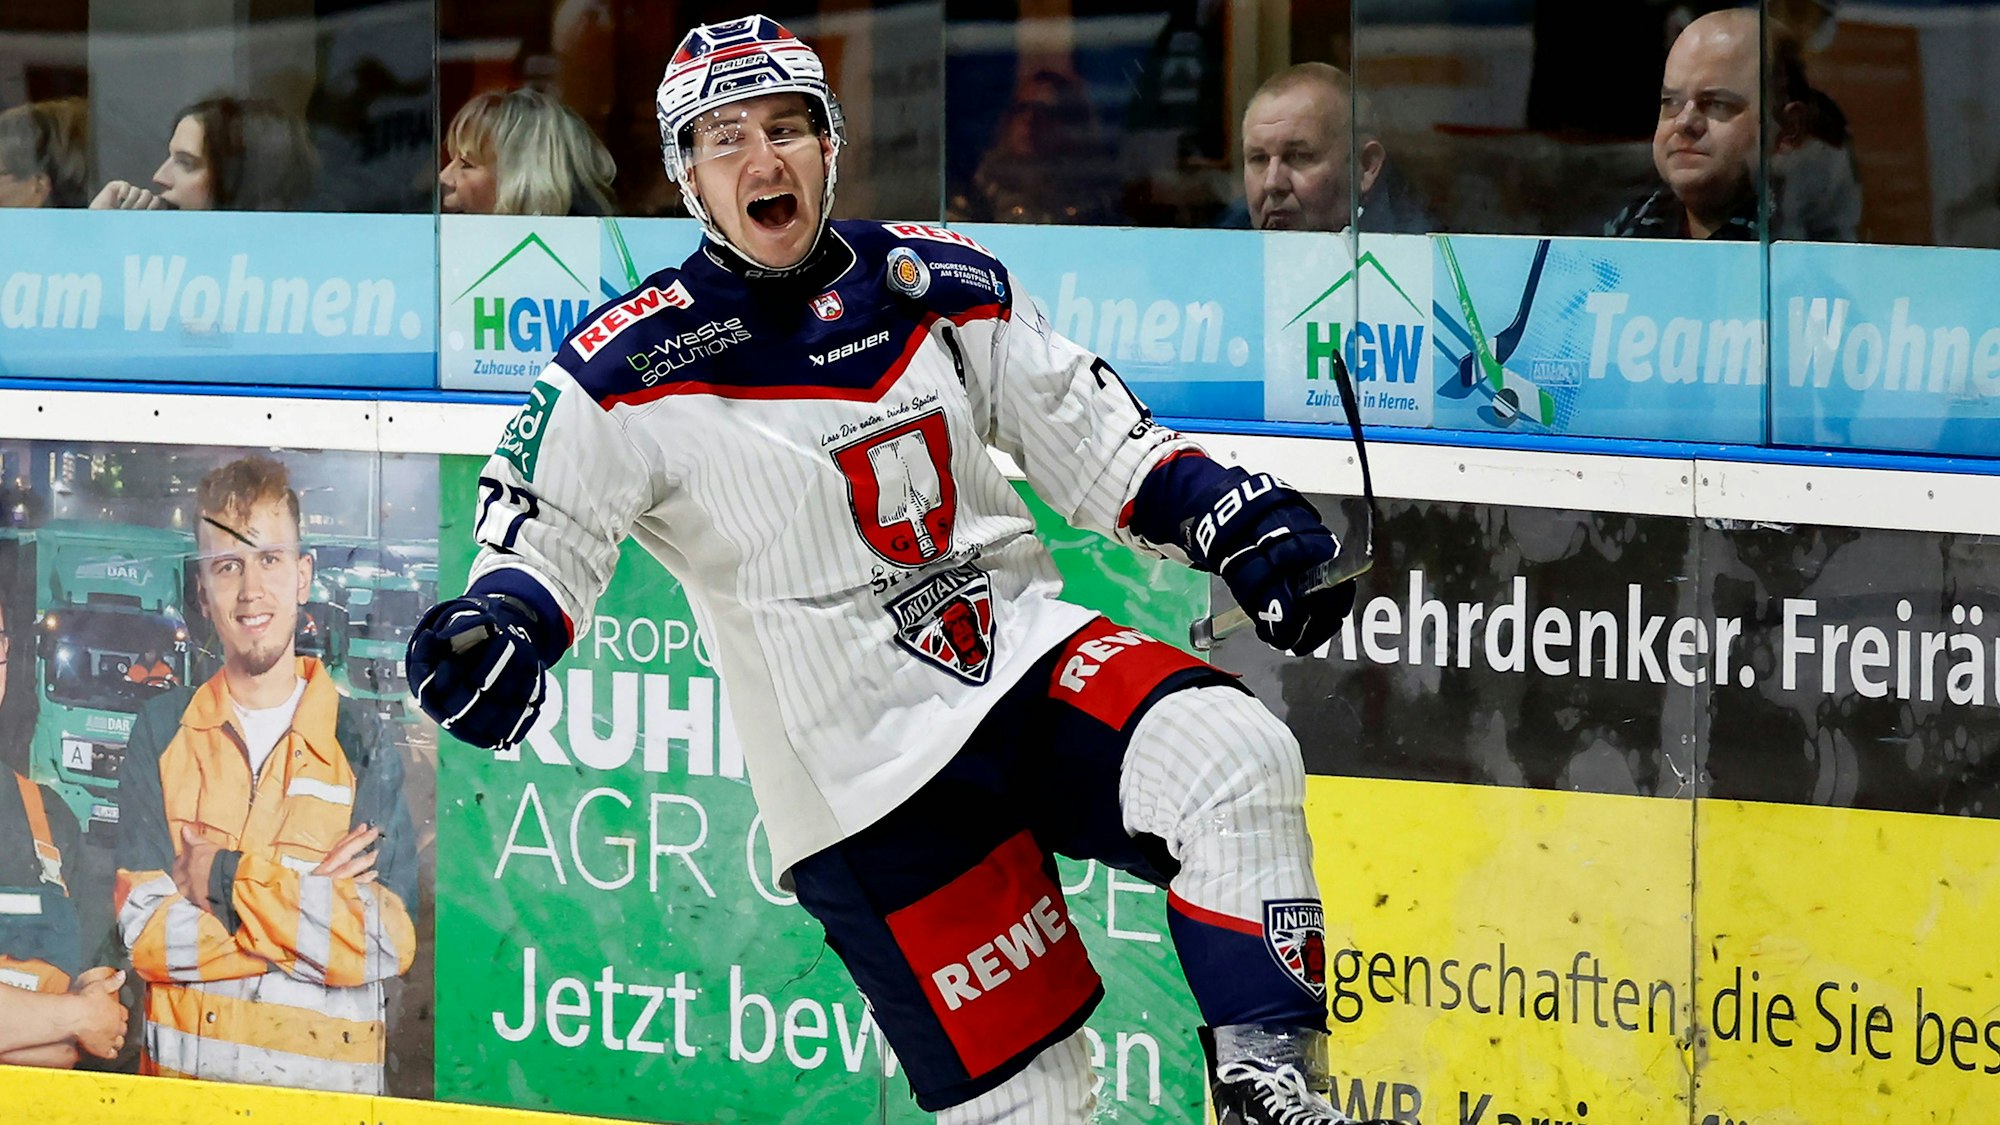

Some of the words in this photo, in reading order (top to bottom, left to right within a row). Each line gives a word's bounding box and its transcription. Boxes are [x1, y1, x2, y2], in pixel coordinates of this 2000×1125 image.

[124, 253, 422, 340] Wohnen.
[474, 297, 590, 353] HGW
[578, 289, 686, 353] REWE
[473, 360, 526, 376] Zuhause
[627, 317, 744, 371] b-waste
[641, 330, 752, 387] SOLUTIONS
[1306, 321, 1425, 383] HGW
[1586, 292, 1769, 385] Team
[1364, 391, 1376, 408] in
[1378, 392, 1419, 411] Herne.
[1783, 598, 2000, 706] Freirä
[71, 745, 84, 765] A
[494, 782, 717, 899] AGR
[932, 895, 1067, 1011] REWE
[492, 947, 697, 1057] Jetzt
[1712, 966, 1795, 1047] die
[1814, 981, 1893, 1060] Sie
